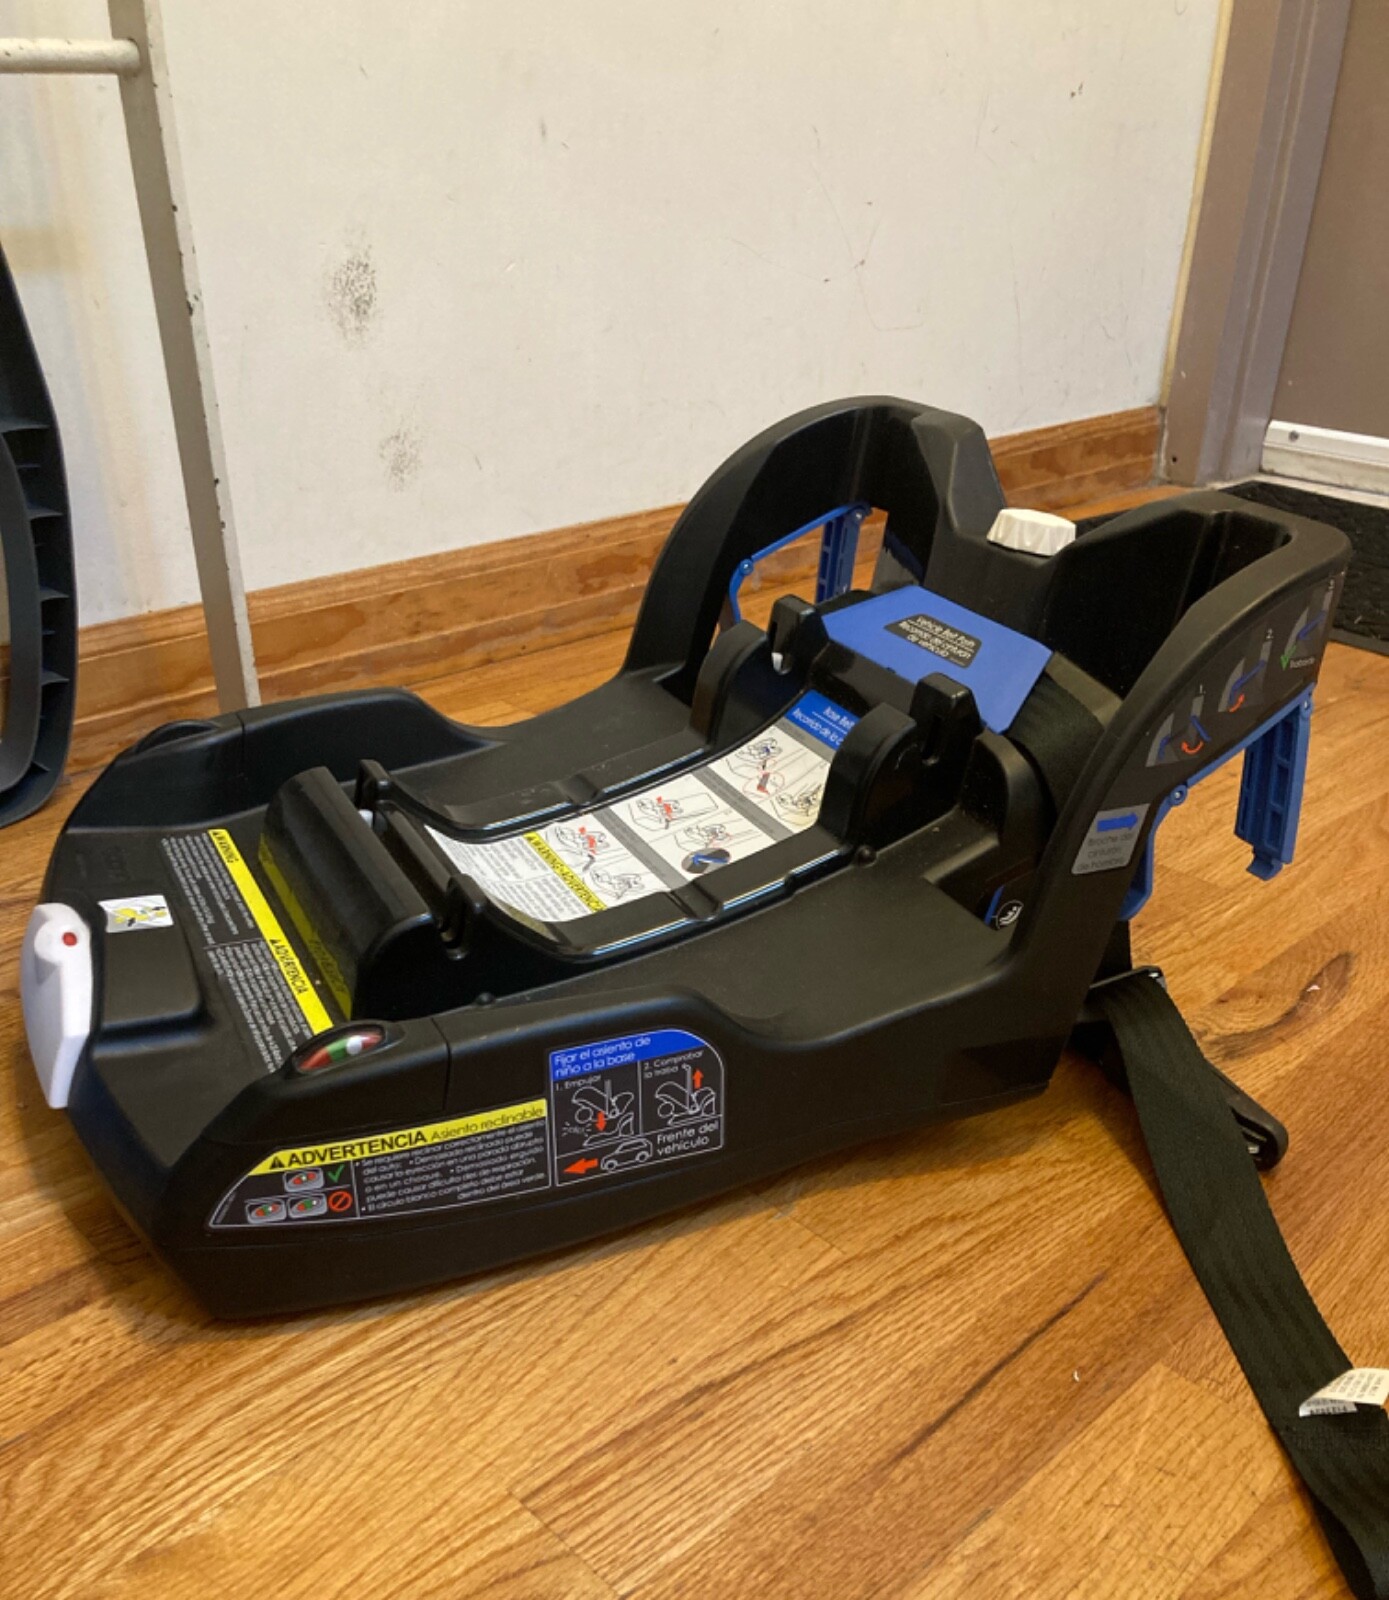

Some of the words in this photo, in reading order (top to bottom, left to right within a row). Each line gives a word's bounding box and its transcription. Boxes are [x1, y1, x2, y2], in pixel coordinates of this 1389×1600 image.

[274, 944, 309, 995] ADVERTENCIA
[554, 1053, 578, 1067] Fijar
[580, 1049, 590, 1060] el
[592, 1040, 632, 1057] asiento
[635, 1036, 651, 1047] de
[555, 1063, 581, 1078] niño
[584, 1062, 592, 1071] a
[593, 1058, 604, 1068] la
[607, 1052, 635, 1067] base
[564, 1074, 602, 1089] Empujar
[287, 1130, 428, 1167] ADVERTENCIA
[431, 1123, 478, 1142] Asiento
[481, 1107, 545, 1130] reclinable
[656, 1127, 696, 1145] Frente
[699, 1121, 719, 1134] del
[656, 1136, 710, 1156] vehículo
